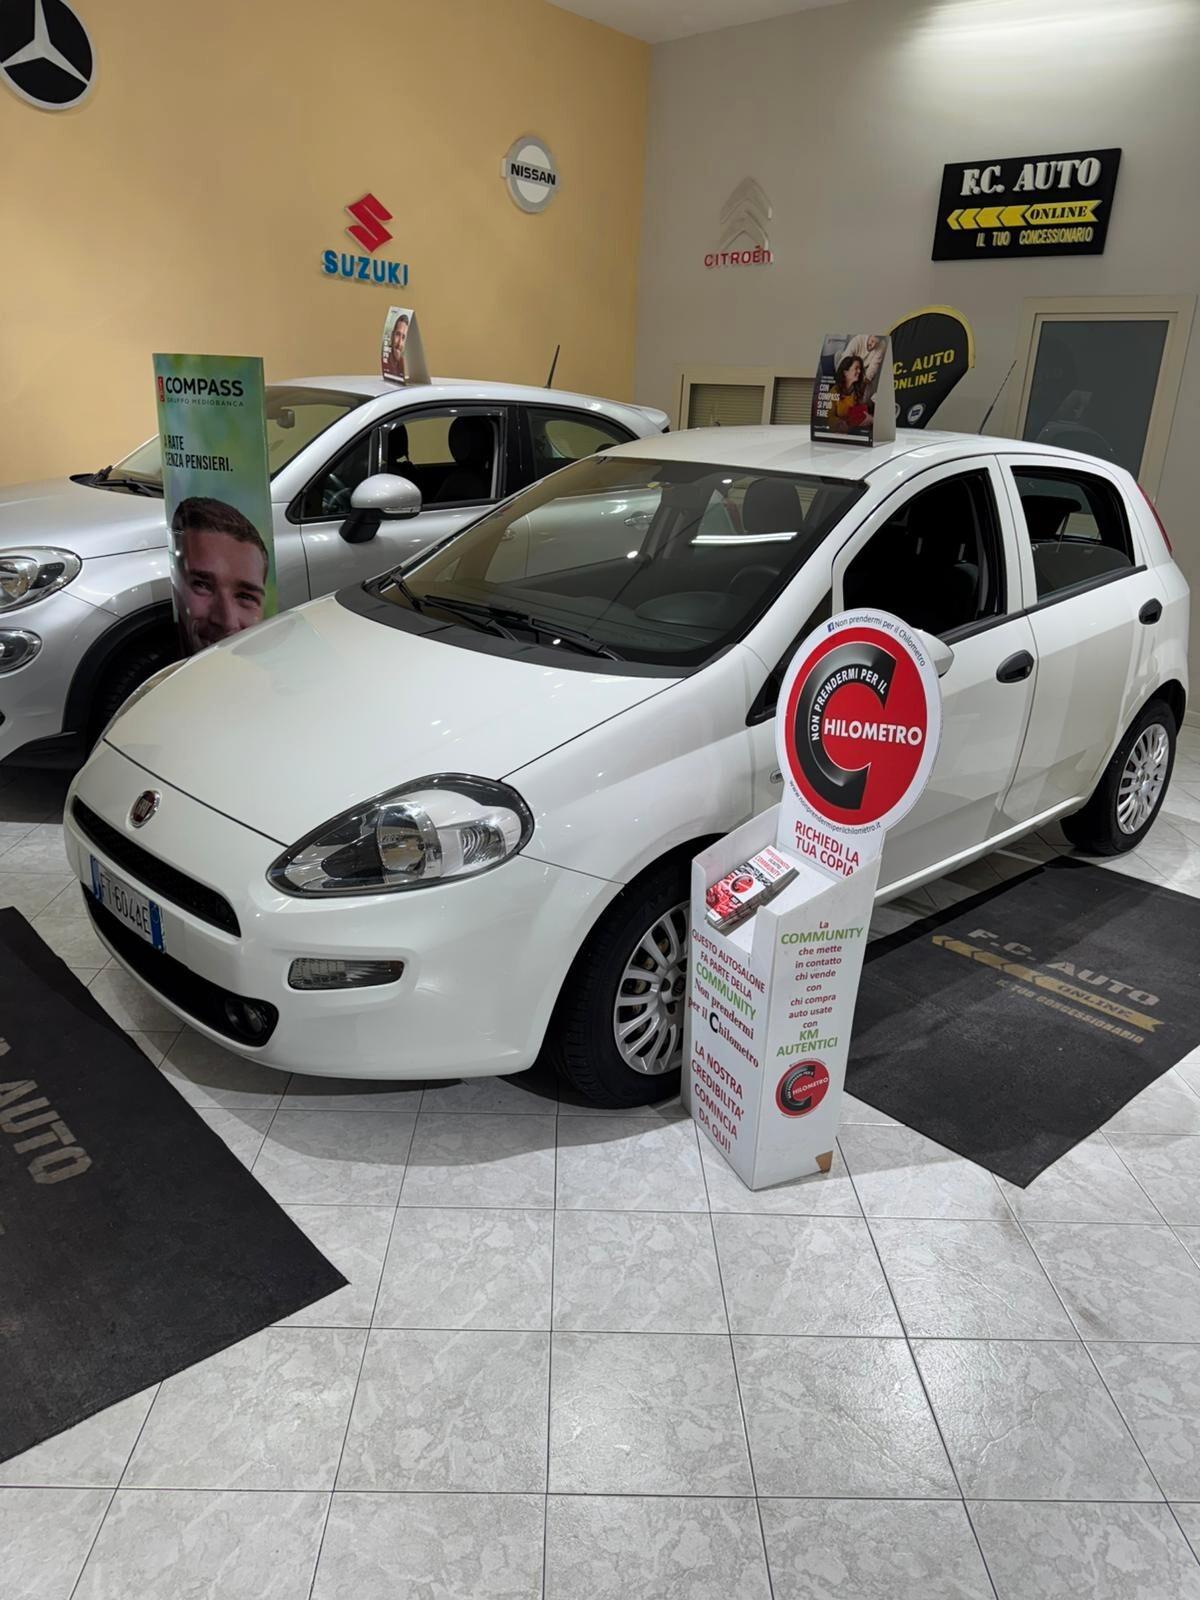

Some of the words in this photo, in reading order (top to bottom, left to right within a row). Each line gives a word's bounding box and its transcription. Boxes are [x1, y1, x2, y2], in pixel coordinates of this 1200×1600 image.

[511, 163, 556, 185] NISSAN
[960, 165, 1006, 196] F.C.
[1012, 157, 1102, 192] AUTO
[1030, 205, 1088, 220] ONLINE
[976, 232, 986, 247] IL
[992, 231, 1012, 246] TUO
[1019, 226, 1095, 245] CONCESSIONARIO
[323, 249, 409, 286] SUZUKI
[911, 349, 955, 372] AUTO
[165, 377, 244, 397] COMPASS
[192, 399, 245, 407] MEDIOBANCA
[185, 454, 234, 472] PENSIERI.
[834, 619, 848, 628] Non
[848, 614, 883, 624] prendermi
[883, 620, 894, 630] per
[894, 625, 899, 633] il
[898, 629, 926, 667] Chilometro
[860, 668, 878, 685] PER
[877, 680, 887, 694] IL
[814, 667, 859, 712] PRENDERMI
[811, 715, 820, 741] NON
[795, 820, 843, 856] RICHIEDI
[845, 847, 859, 867] LA
[795, 836, 817, 858] TUA
[820, 850, 854, 876] COPIA
[819, 920, 829, 929] La
[780, 927, 864, 945] COMMUNITY
[691, 929, 718, 954] QUESTO
[718, 949, 765, 993] AUTOSALONE
[798, 947, 814, 956] che
[816, 945, 842, 955] mette
[795, 961, 804, 969] in
[805, 957, 842, 968] contatto
[700, 951, 709, 965] FA
[709, 958, 730, 982] PARTE
[731, 975, 752, 1000] DELLA
[795, 971, 808, 981] chi
[810, 969, 836, 979] vende
[1046, 961, 1161, 1006] AUTO
[696, 962, 756, 1021] COMMUNITY
[806, 984, 822, 992] con
[695, 978, 710, 1000] Non
[711, 995, 754, 1040] prendermi
[790, 997, 803, 1007] chi
[805, 994, 836, 1006] compra
[1058, 985, 1134, 1018] ONLINE
[788, 1009, 808, 1019] auto
[810, 1006, 832, 1016] usate
[1036, 995, 1145, 1044] CONCESSIONARIO
[688, 996, 701, 1013] per
[701, 1004, 708, 1020] il
[709, 1011, 759, 1068] Chilometro
[800, 1029, 819, 1041] KM
[802, 1020, 818, 1029] con
[776, 1037, 838, 1057] AUTENTICI
[695, 1040, 705, 1061] LA
[707, 1053, 743, 1100] NOSTRA
[694, 1083, 738, 1140] COMINCIA
[699, 1107, 710, 1130] DA
